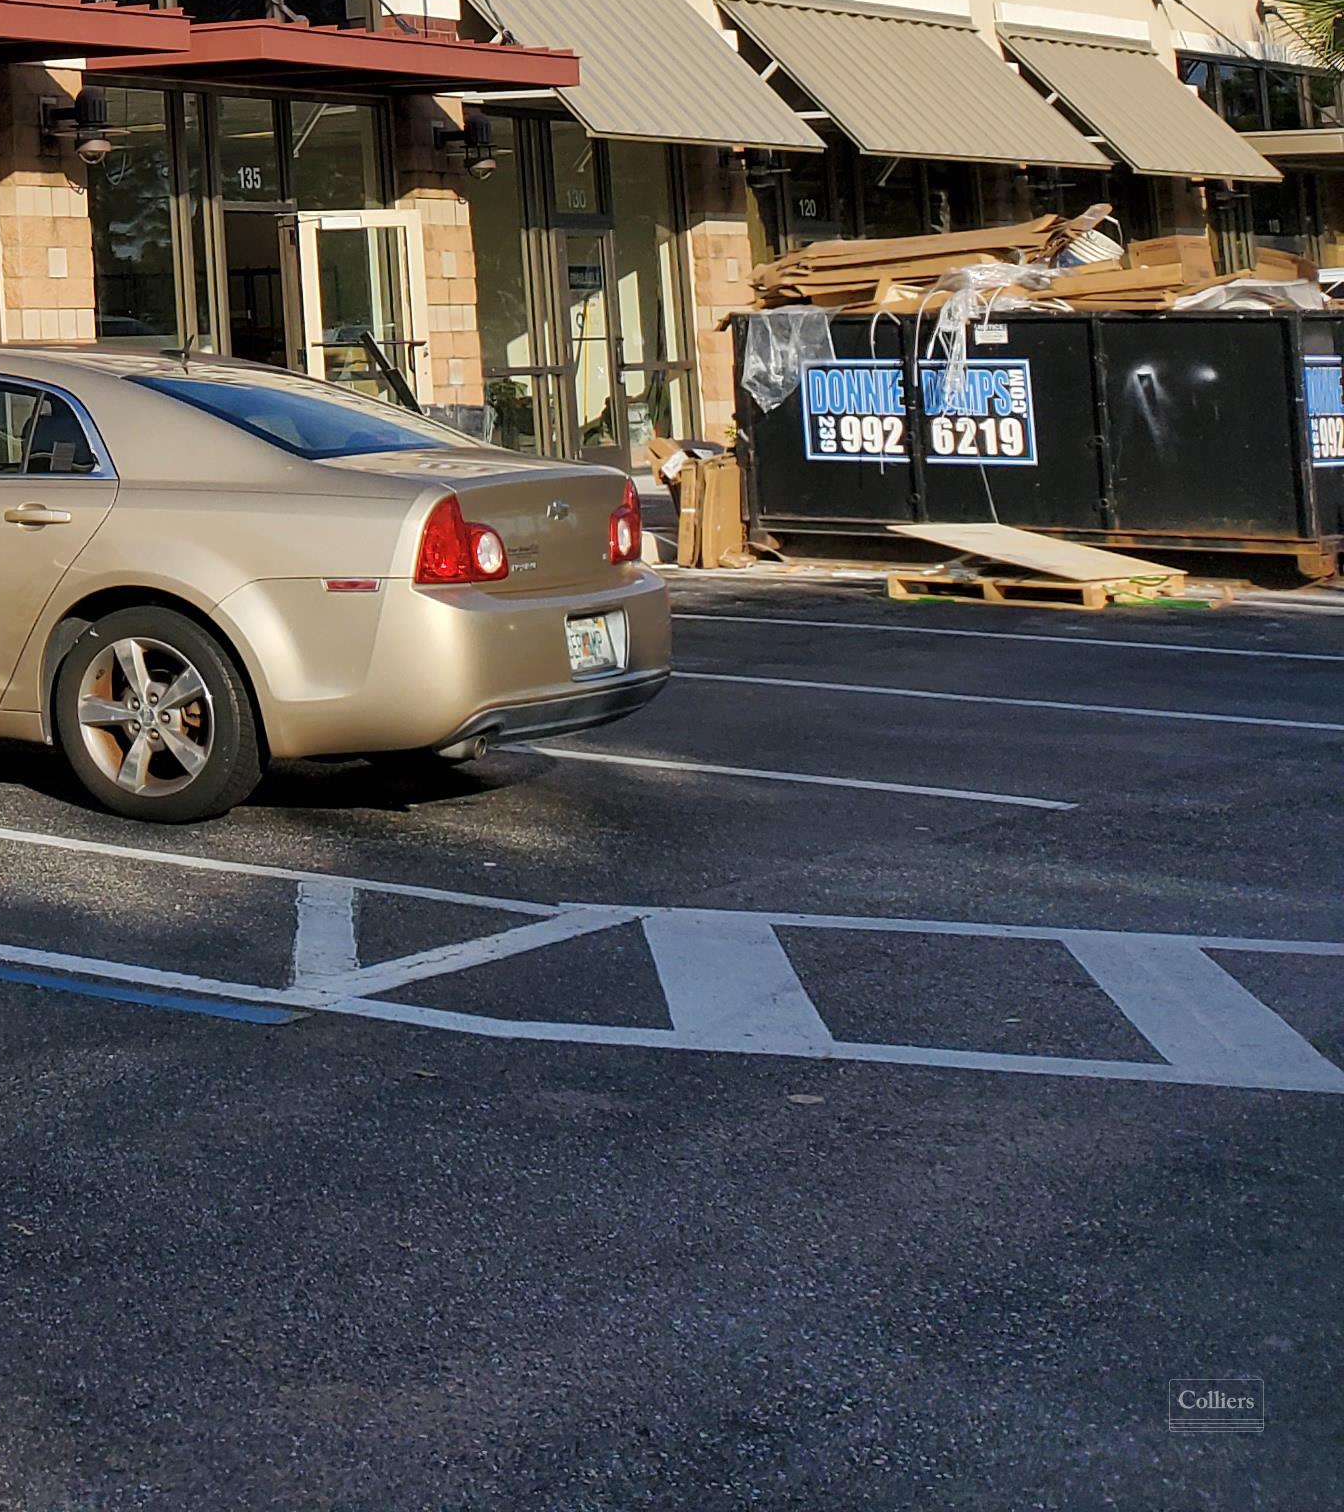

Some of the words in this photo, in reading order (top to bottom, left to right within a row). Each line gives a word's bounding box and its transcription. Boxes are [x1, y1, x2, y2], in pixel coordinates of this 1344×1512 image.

[237, 166, 262, 189] 135
[567, 189, 587, 209] 130
[798, 198, 817, 217] 120
[808, 369, 906, 415] DONNIE
[818, 415, 837, 454] 239
[839, 415, 905, 454] 992
[932, 417, 1025, 456] 6219
